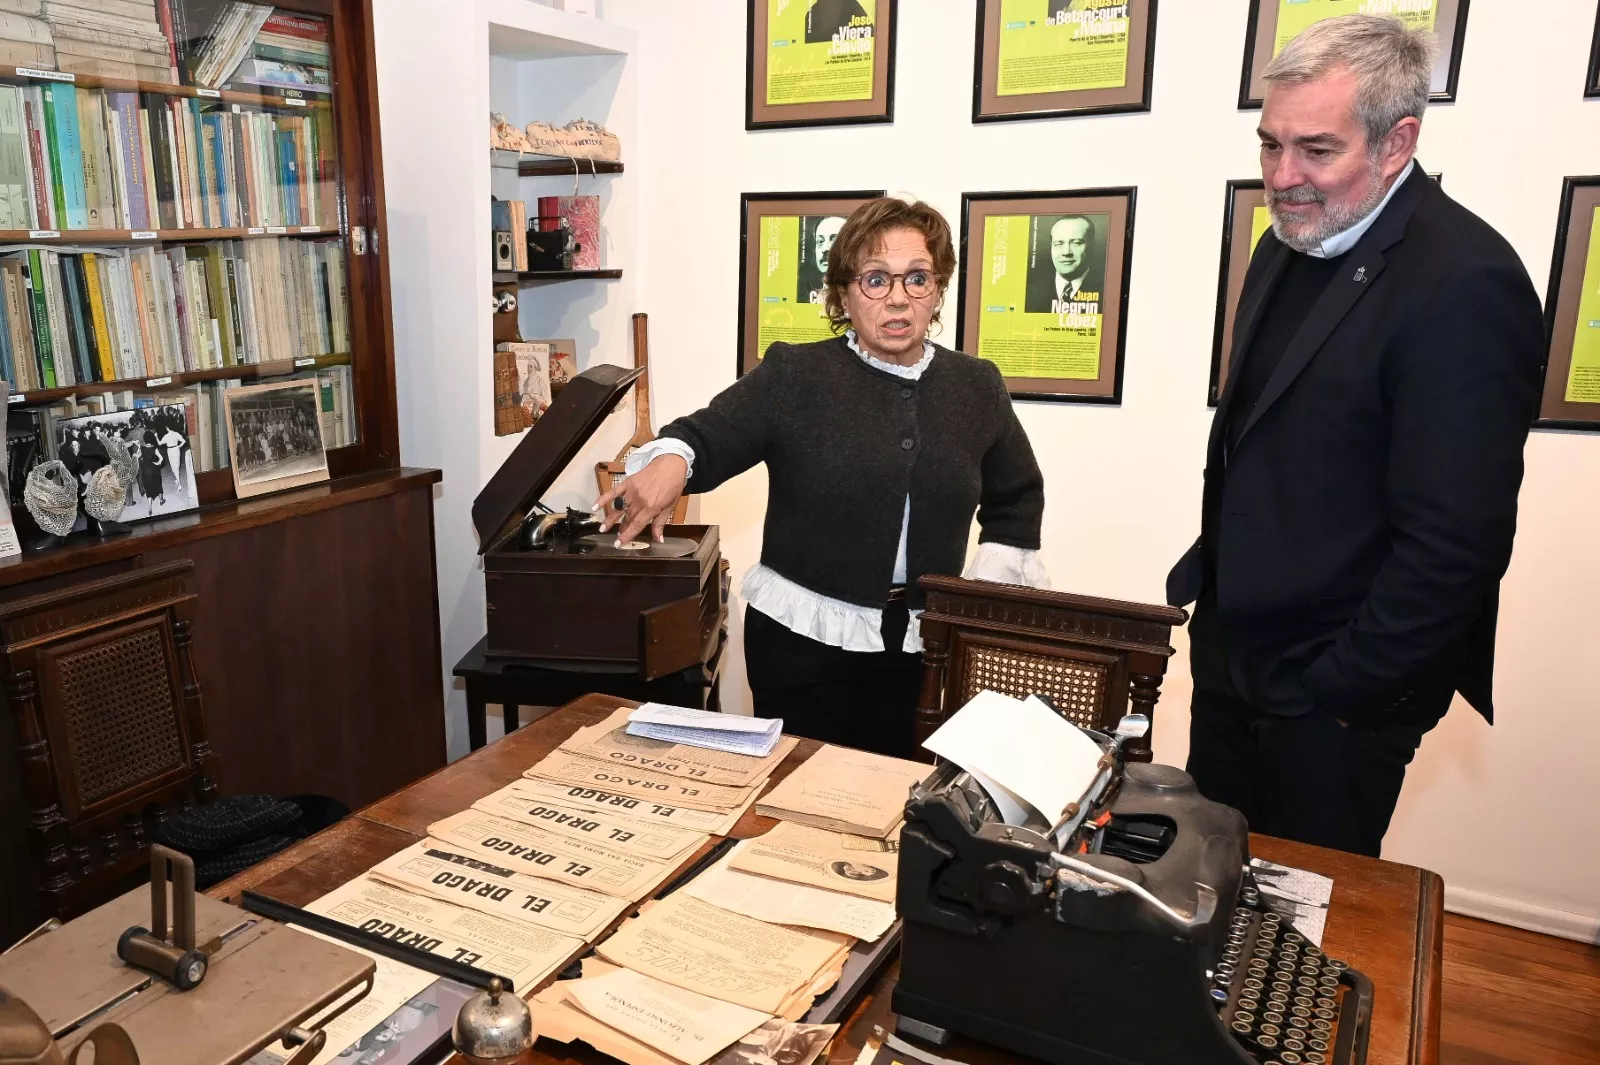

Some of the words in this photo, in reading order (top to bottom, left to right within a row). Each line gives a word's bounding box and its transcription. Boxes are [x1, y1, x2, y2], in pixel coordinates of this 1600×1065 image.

[1056, 4, 1128, 25] Betancourt
[839, 25, 872, 40] Viera
[1080, 20, 1126, 37] Molina
[832, 38, 871, 56] Clavijo
[286, 88, 303, 98] HIERRO
[1073, 290, 1099, 301] Juan
[609, 752, 680, 771] DRAGO
[687, 768, 708, 777] EL
[593, 773, 671, 791] DRAGO
[567, 786, 640, 809] DRAGO
[679, 787, 701, 796] EL
[528, 806, 602, 833] DRAGO
[651, 804, 677, 817] EL
[608, 828, 637, 843] EL
[481, 837, 557, 866] DRAGO
[563, 861, 593, 877] EL
[432, 871, 513, 902] DRAGO
[521, 894, 552, 914] EL
[359, 918, 444, 953] DRAGO
[467, 932, 516, 952] EDITORIAL
[450, 947, 484, 965] EL
[625, 946, 768, 995] HESPERIDES
[647, 1009, 689, 1034] ALFONSO
